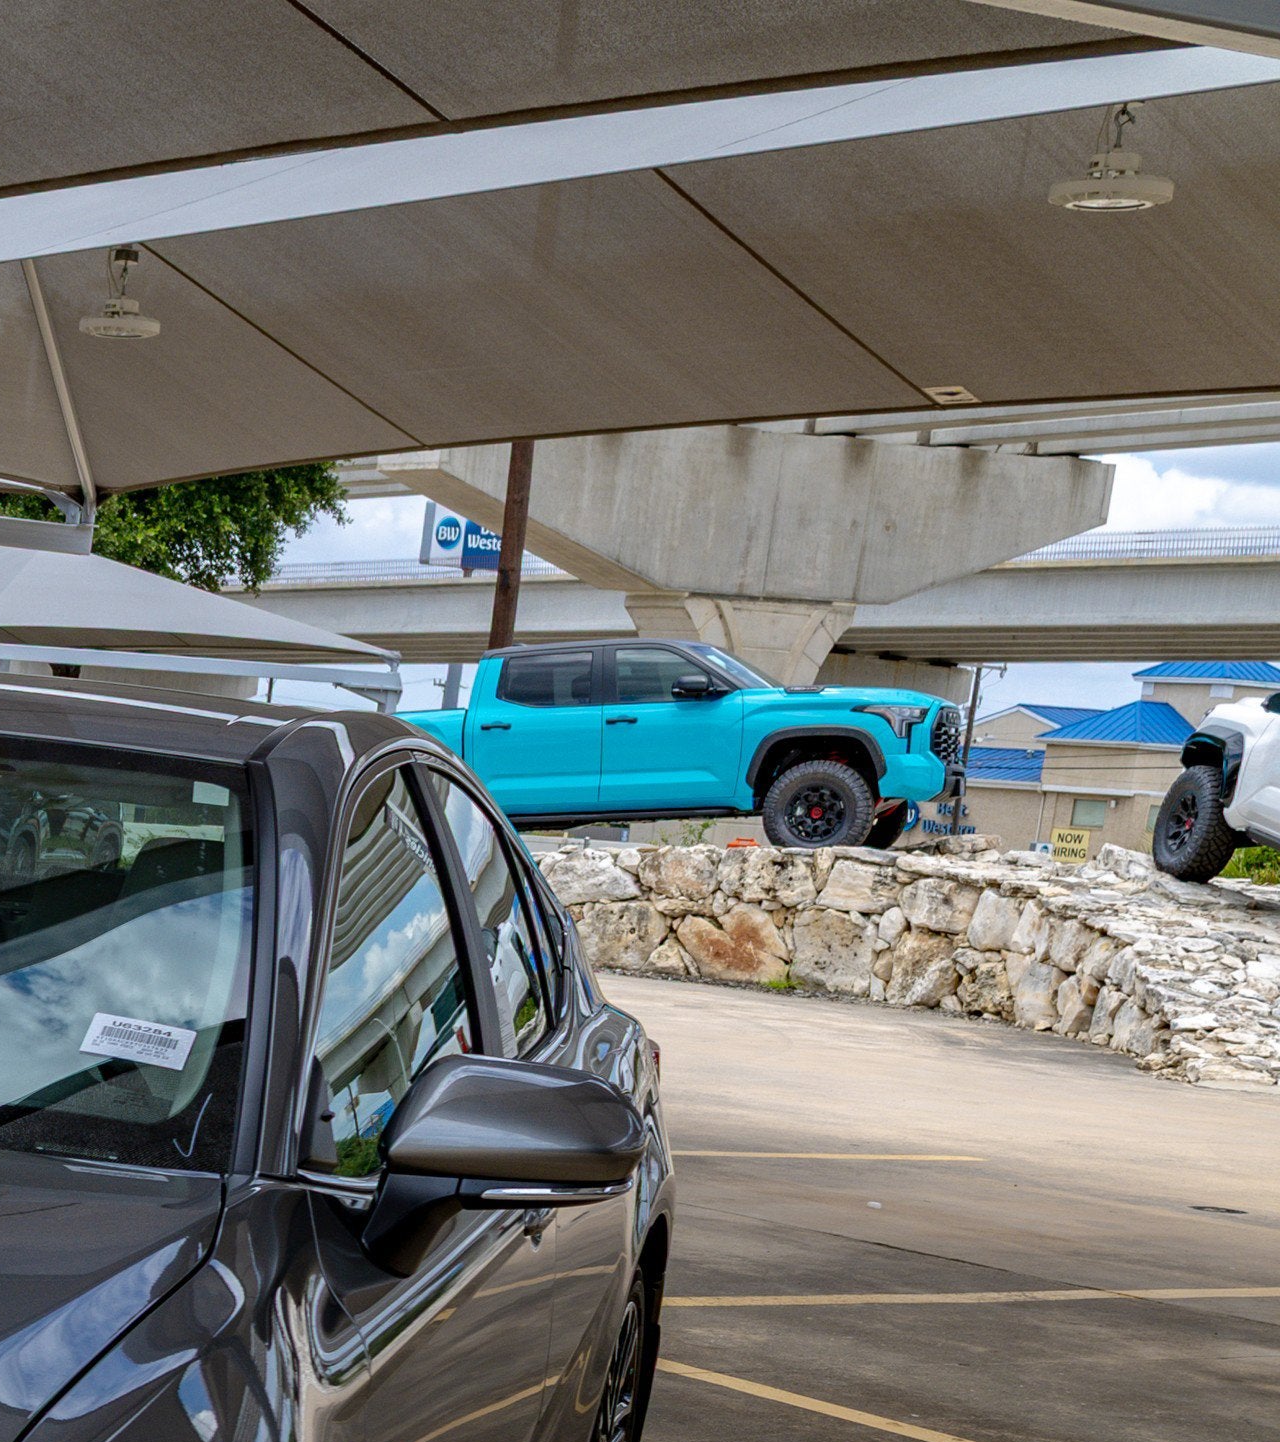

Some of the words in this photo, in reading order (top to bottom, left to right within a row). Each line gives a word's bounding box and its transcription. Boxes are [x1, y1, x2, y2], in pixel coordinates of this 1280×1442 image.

[438, 526, 459, 541] BW
[937, 803, 967, 817] Bet
[922, 820, 976, 835] Westrn
[1057, 833, 1084, 844] NOW
